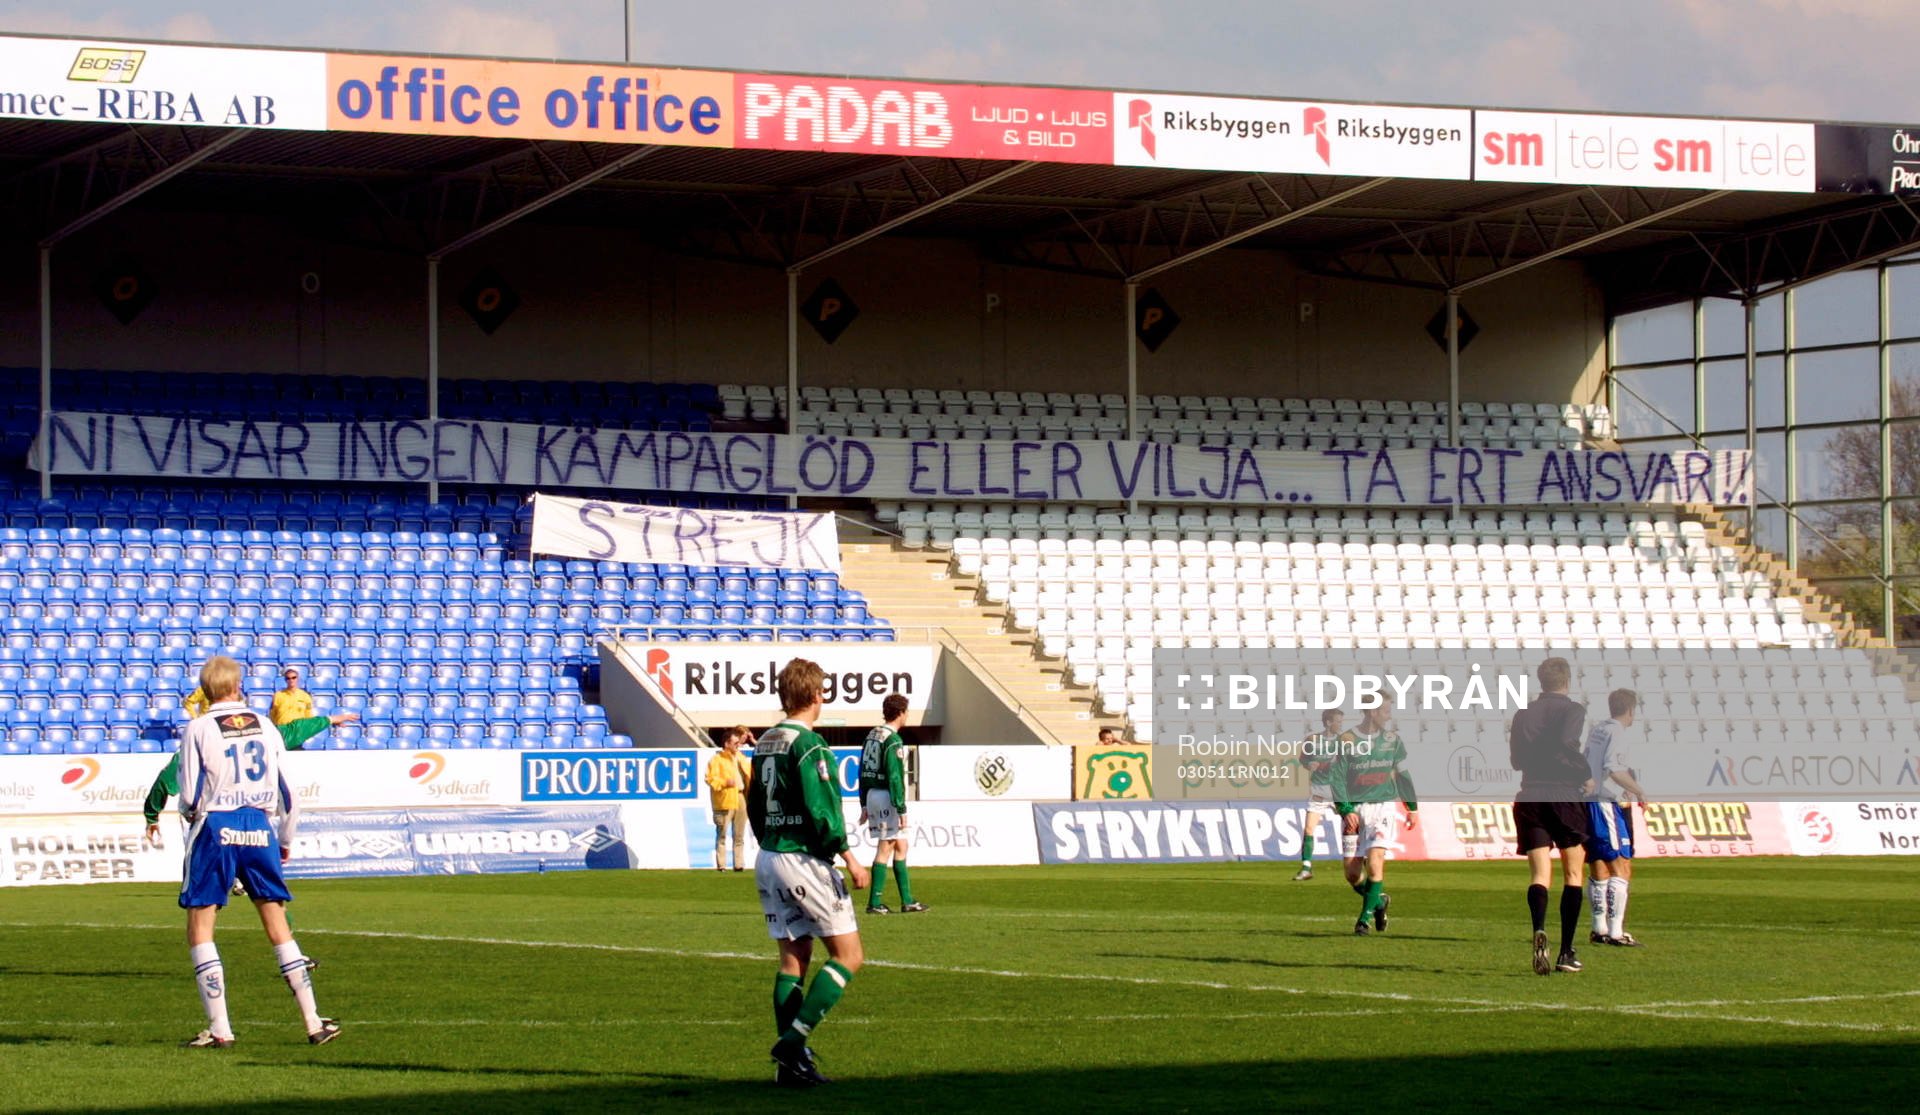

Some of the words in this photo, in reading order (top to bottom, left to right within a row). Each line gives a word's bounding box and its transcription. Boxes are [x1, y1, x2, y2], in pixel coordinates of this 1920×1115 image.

[78, 57, 136, 72] BOSS
[223, 95, 276, 126] AB
[337, 66, 520, 127] office
[545, 76, 721, 135] office
[744, 82, 953, 148] PADAB
[972, 106, 1029, 125] LJUD
[1052, 110, 1107, 127] LJUS
[1163, 111, 1291, 138] Riksbyggen
[1337, 118, 1462, 146] Riksbyggen
[1003, 130, 1020, 145] &
[1028, 130, 1076, 148] BILD
[1483, 131, 1543, 166] sm
[1568, 126, 1639, 170] tele
[1653, 138, 1711, 173] sm
[1737, 132, 1806, 177] tele
[48, 415, 113, 473] NI
[131, 417, 310, 478] VISAR
[339, 420, 508, 483] INGEN
[535, 426, 875, 495] KÄMPAGLÖD
[908, 441, 1083, 499] ELLER
[1428, 446, 1523, 504] ERT
[578, 502, 836, 570] STREJK
[684, 661, 913, 704] Riksggen
[224, 740, 267, 784] 13
[526, 757, 692, 796] PROFFICE
[1741, 755, 1882, 787] CARTON
[427, 780, 491, 800] sydkraft
[1451, 802, 1518, 842] SPO
[1644, 802, 1754, 842] SPORT
[11, 833, 165, 855] HOLMEN
[413, 829, 571, 855] UMBRO
[1466, 846, 1514, 858] BLA
[1657, 843, 1755, 855] BLADET
[14, 858, 136, 881] PAPER
